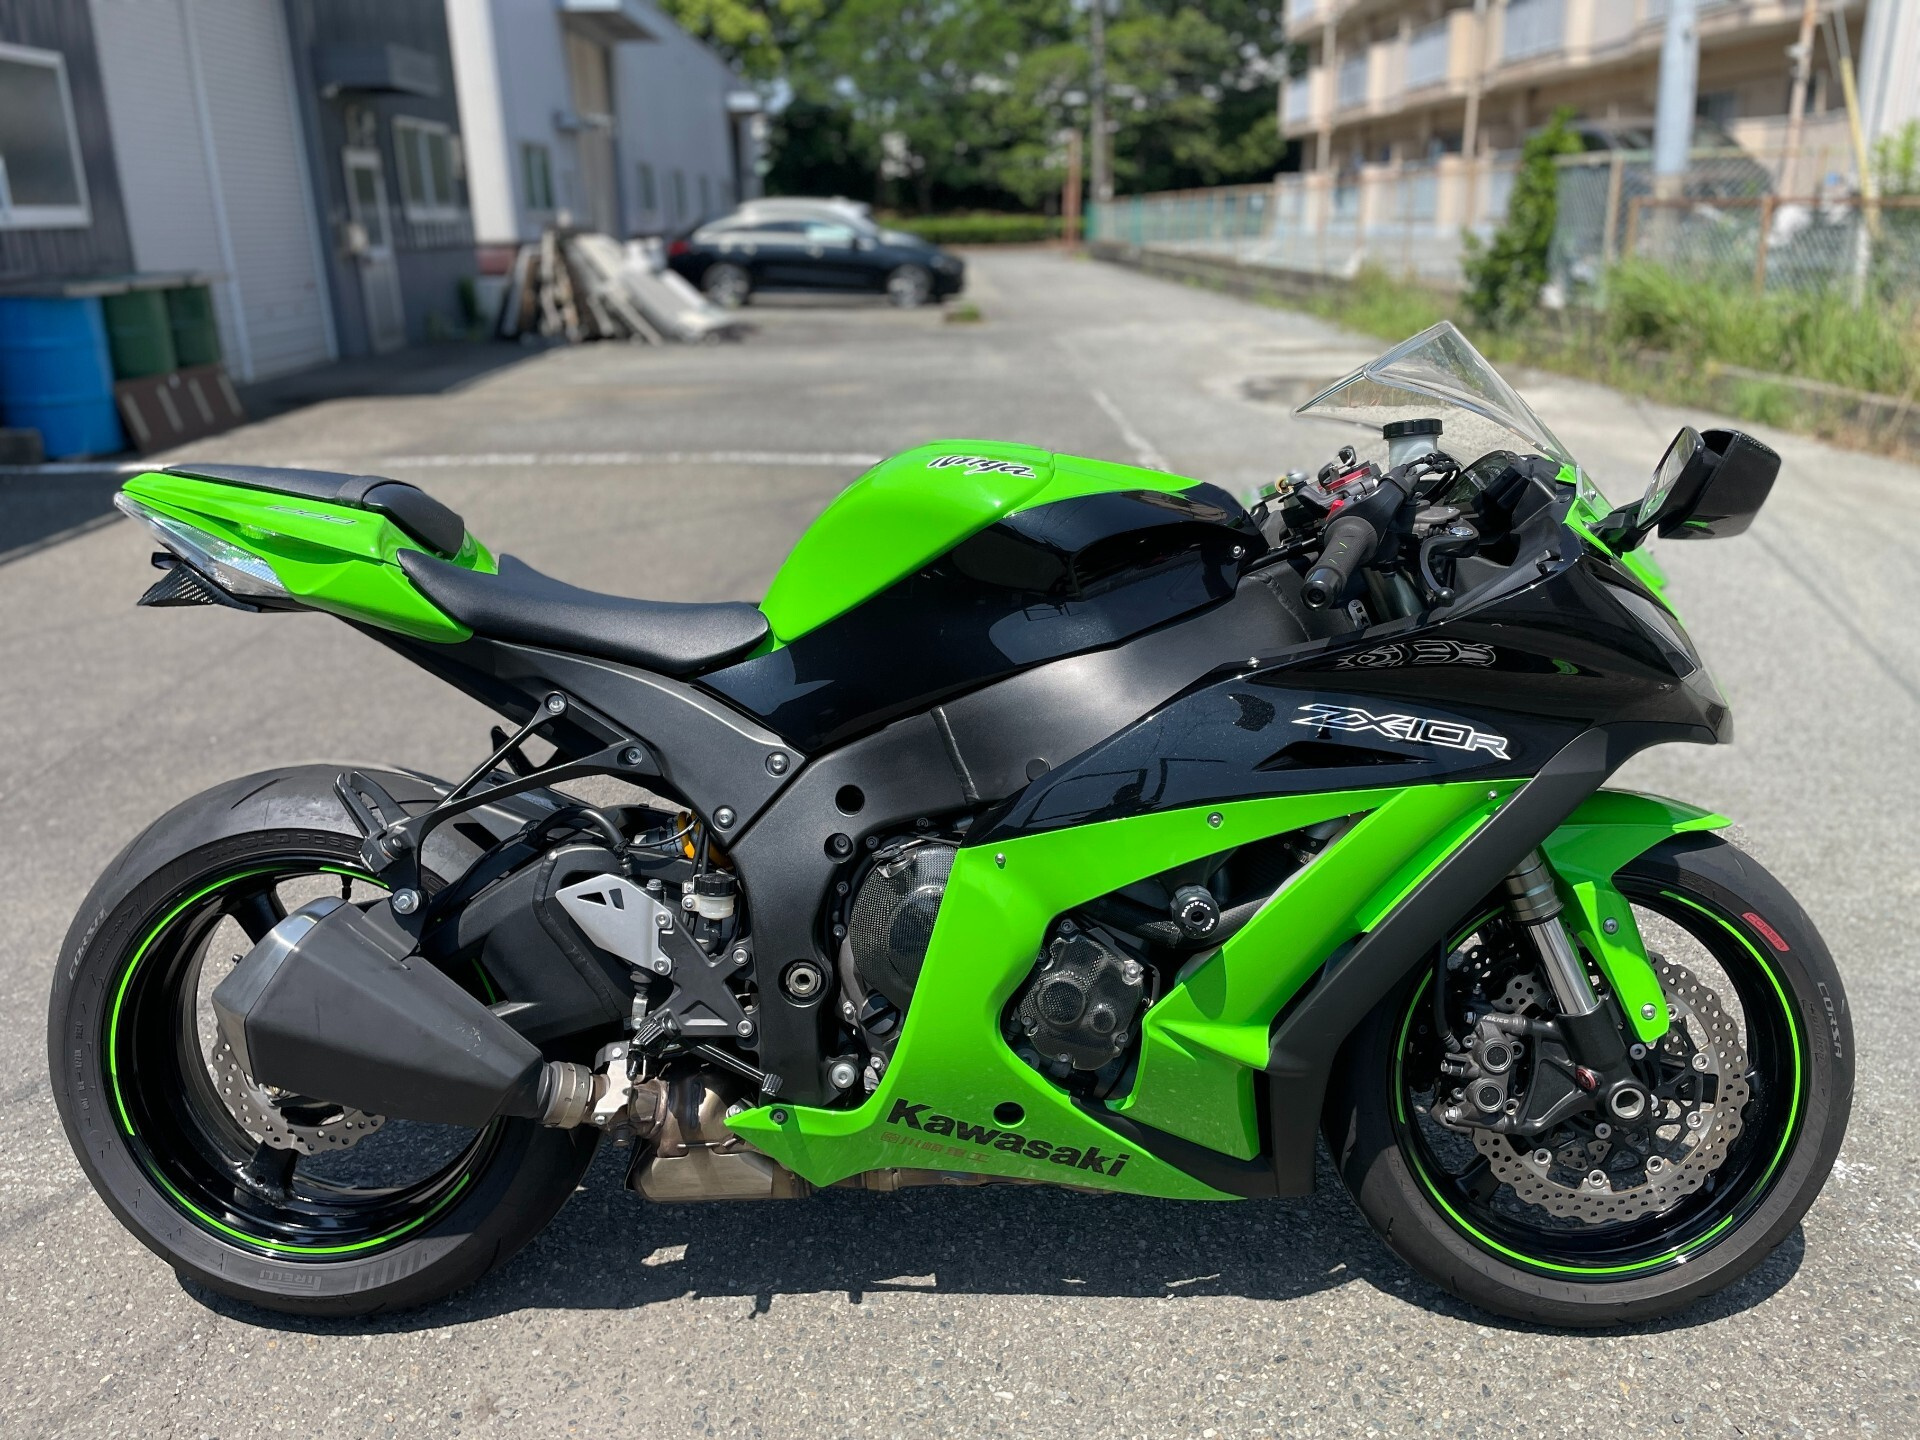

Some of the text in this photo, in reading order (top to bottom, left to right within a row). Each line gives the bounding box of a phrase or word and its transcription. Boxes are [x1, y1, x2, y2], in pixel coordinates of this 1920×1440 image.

[927, 455, 1036, 478] Ninja
[296, 832, 364, 850] ROSS
[68, 908, 108, 981] CORSA
[1746, 913, 1786, 950] CORSA
[1817, 982, 1843, 1059] CORSA
[886, 1098, 1131, 1177] Kawasaki
[259, 1268, 323, 1292] PIRELLI
